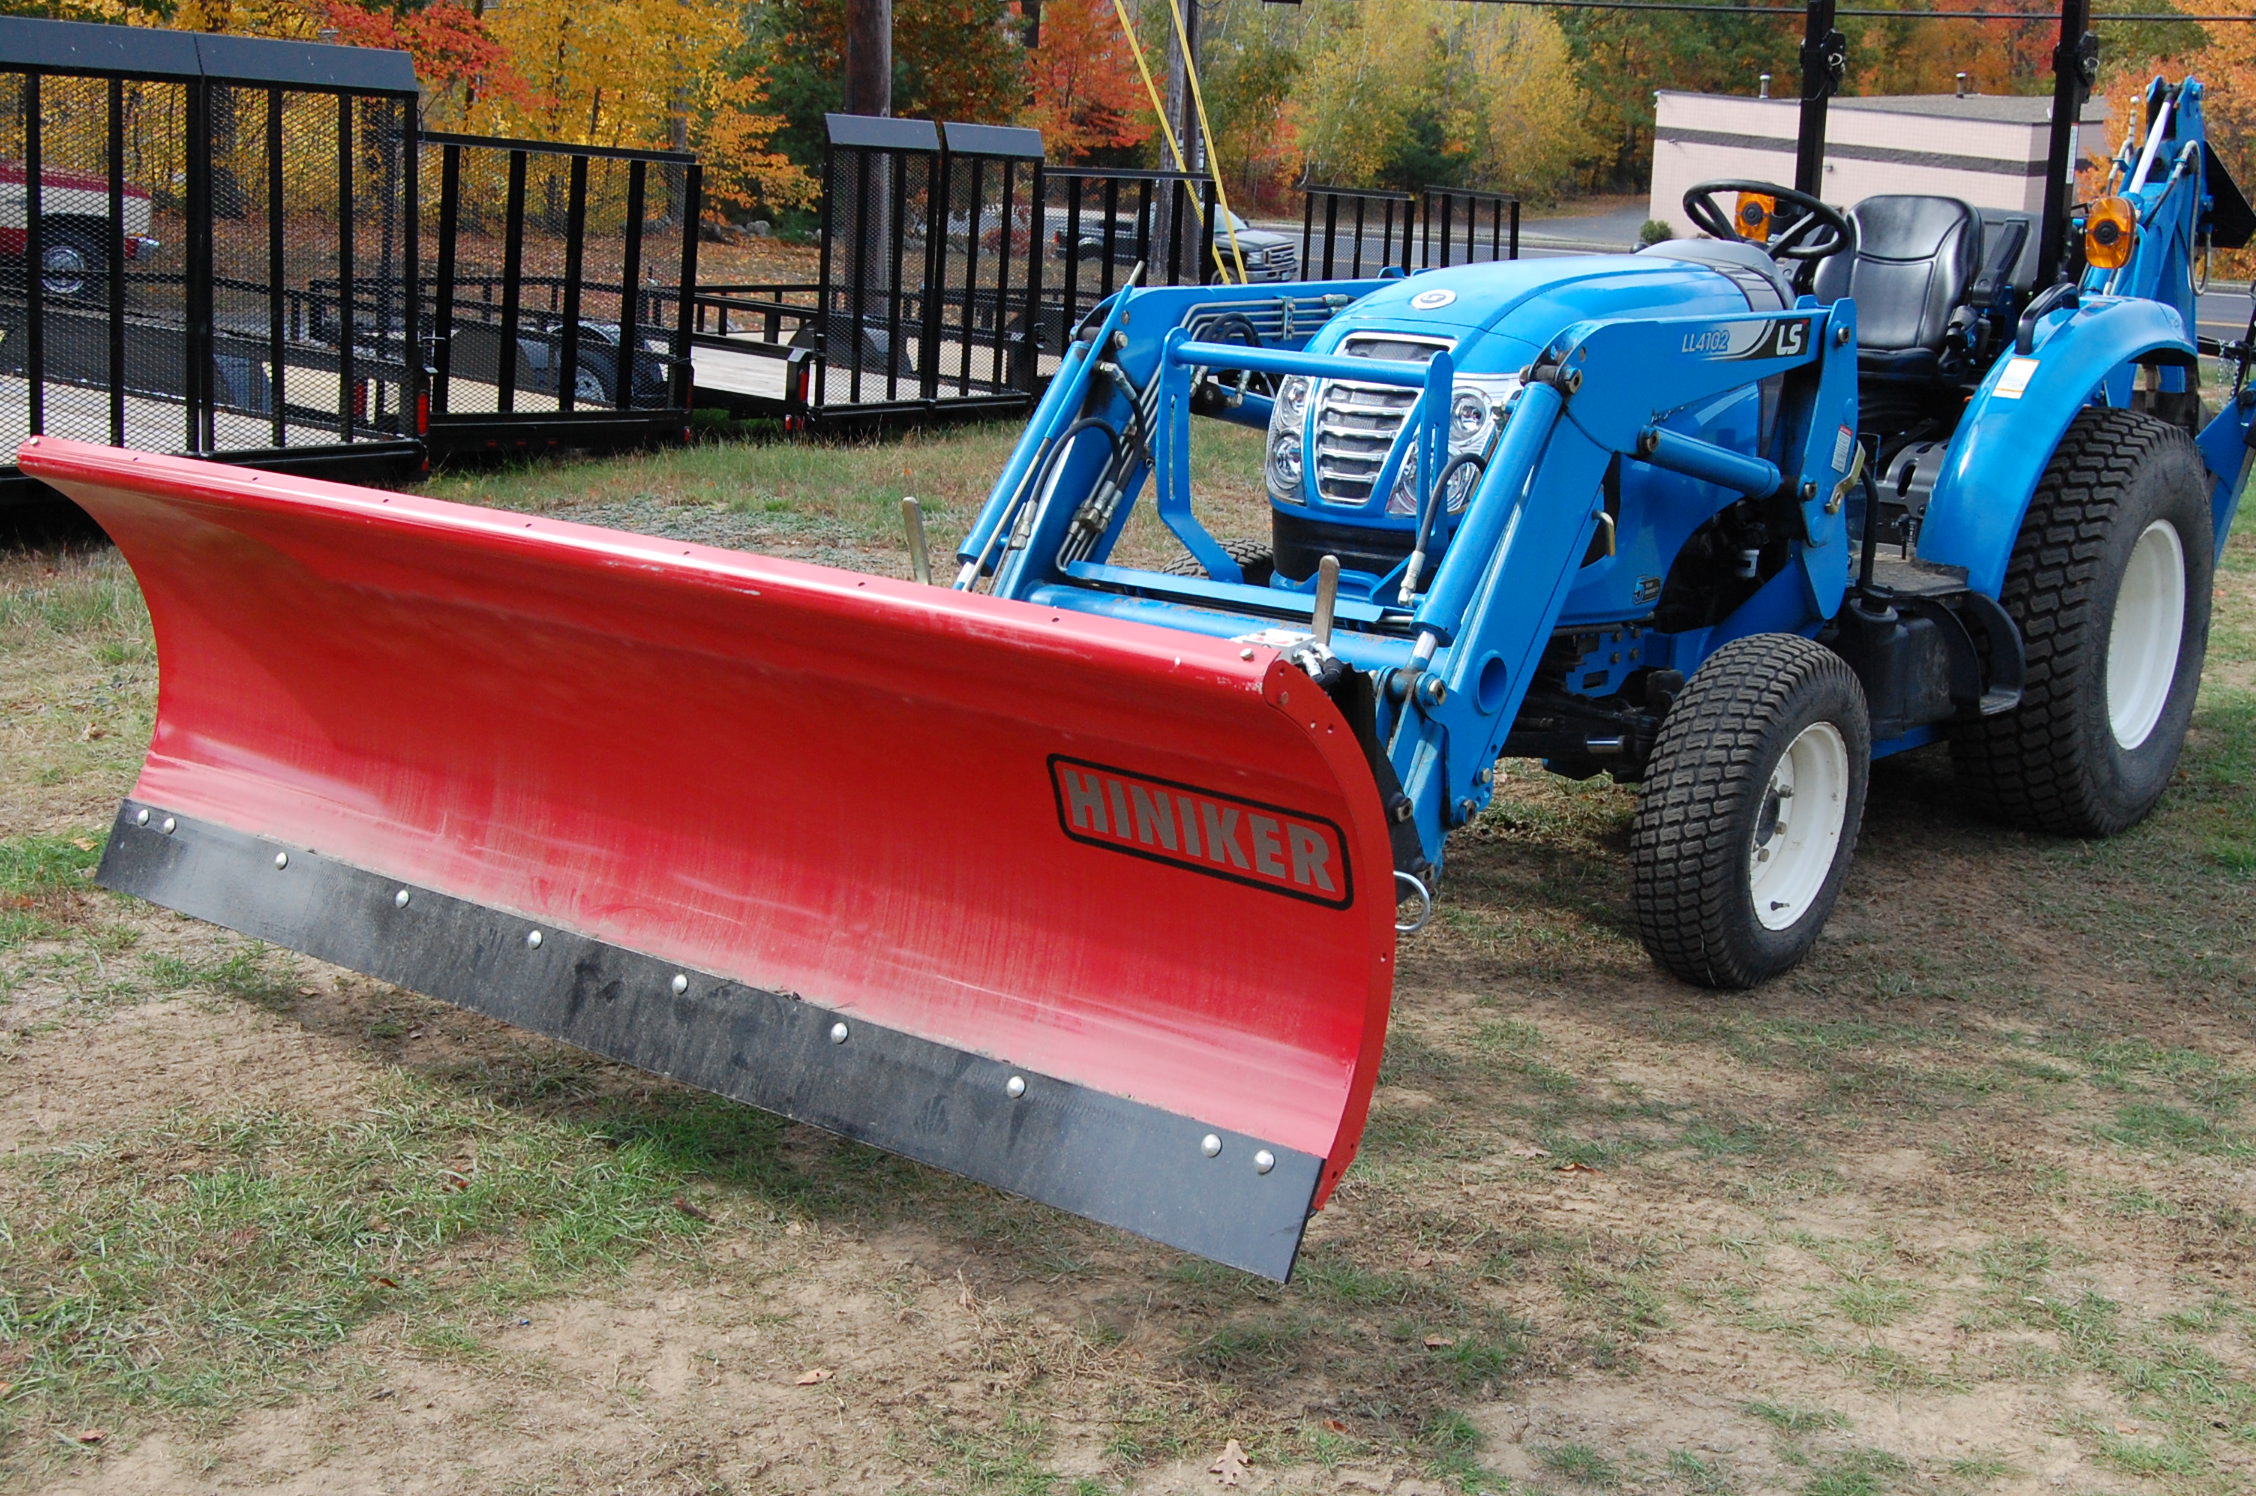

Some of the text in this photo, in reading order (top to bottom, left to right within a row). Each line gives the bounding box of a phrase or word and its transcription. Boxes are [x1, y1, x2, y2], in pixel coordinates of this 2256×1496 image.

[1682, 323, 1803, 356] LL4102 LS
[1063, 769, 1337, 893] HINIKER
